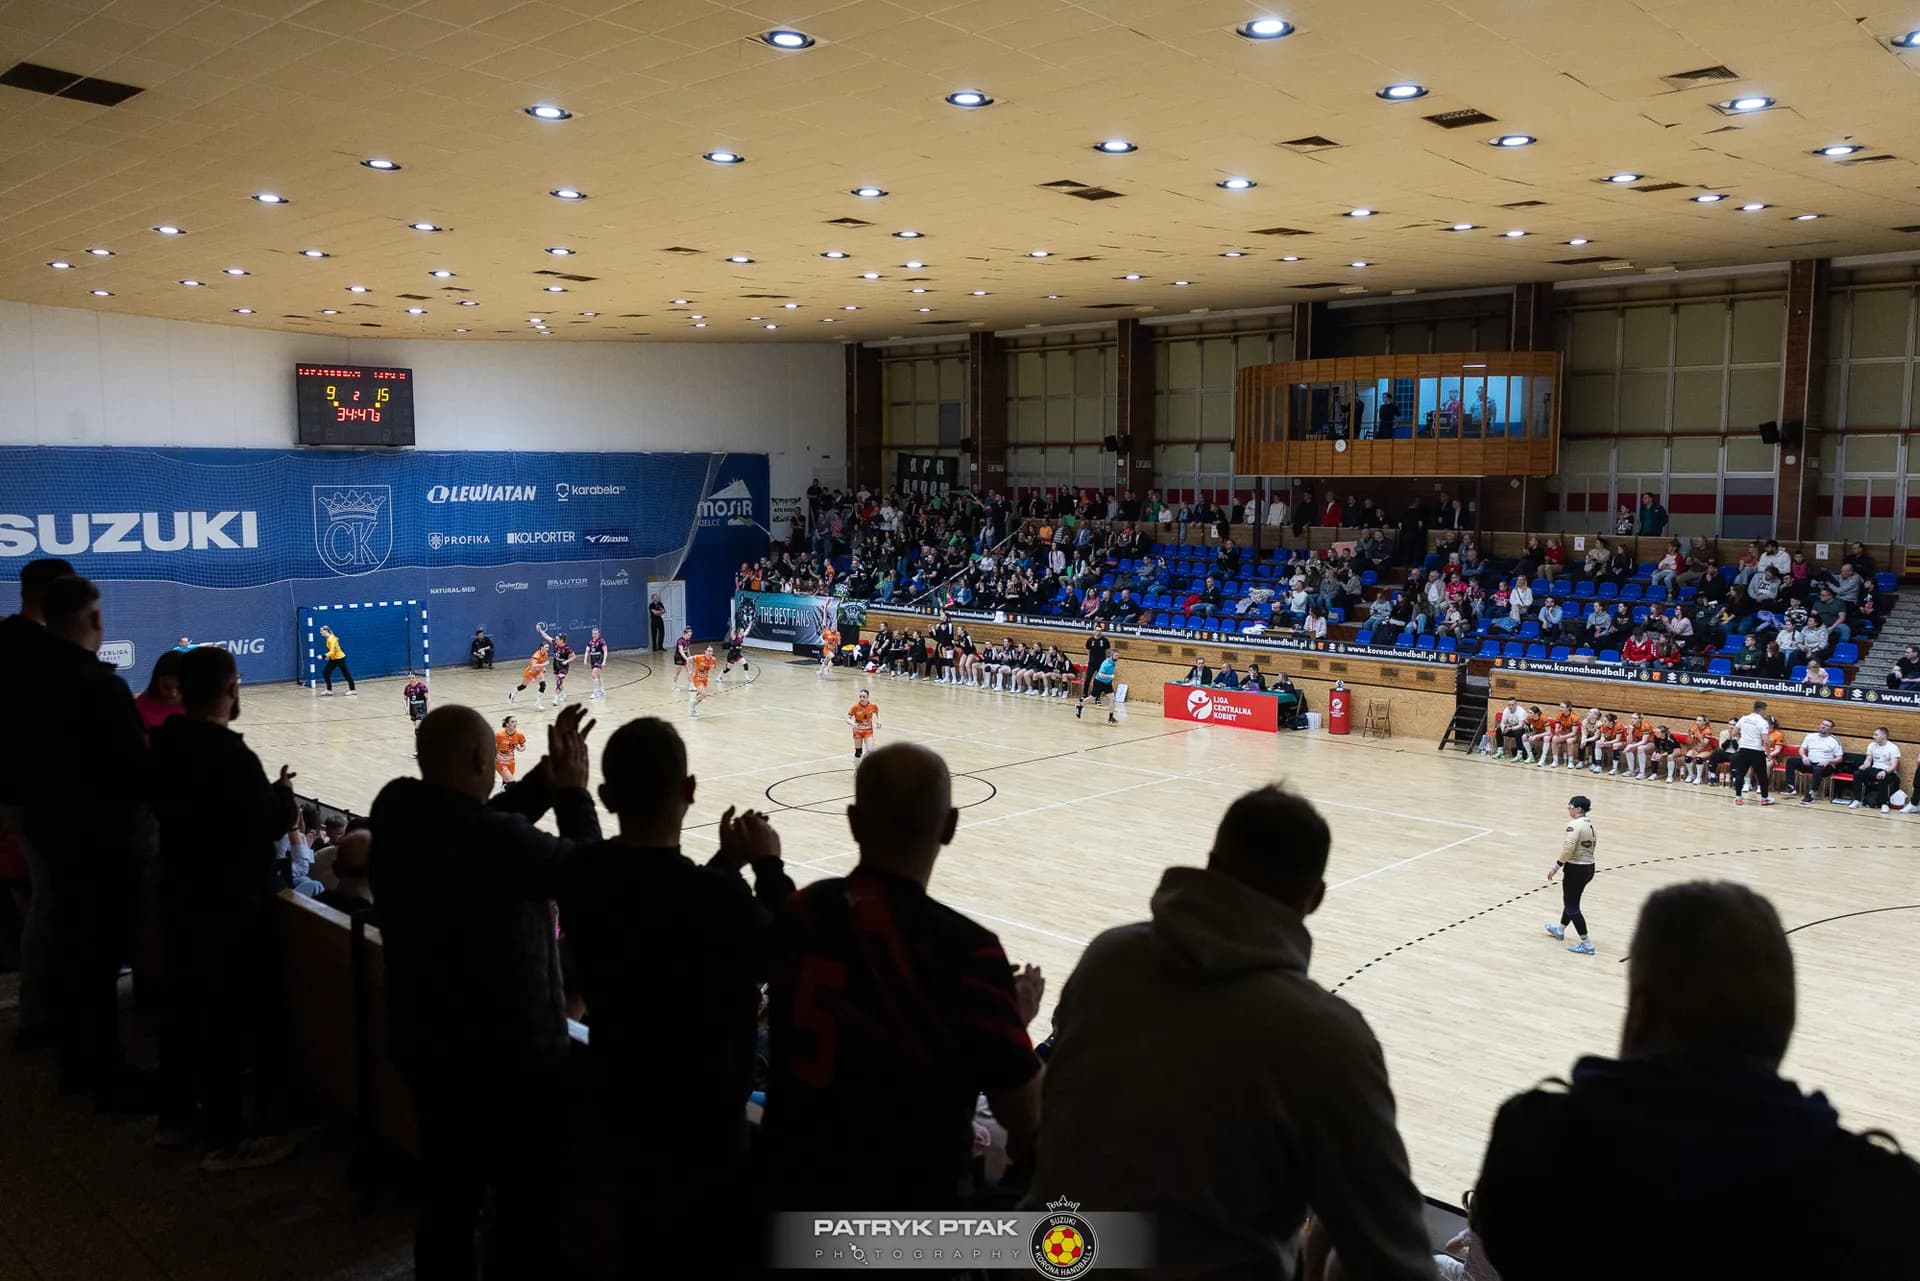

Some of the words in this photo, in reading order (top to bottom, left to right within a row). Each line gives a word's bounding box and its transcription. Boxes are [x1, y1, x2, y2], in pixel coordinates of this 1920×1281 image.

[327, 385, 336, 400] 9
[353, 391, 360, 401] 2
[377, 388, 390, 402] 15
[450, 483, 537, 502] LEWIATAN
[571, 485, 621, 496] karabela
[0, 511, 259, 557] SUZUKI
[444, 535, 491, 545] PROFIKA
[514, 531, 576, 545] KOLPORTER
[323, 521, 380, 567] CK
[759, 606, 773, 625] THE
[774, 607, 792, 626] BEST
[791, 609, 811, 628] FANS
[1228, 634, 1308, 650] www.koronahandball.pl
[1347, 644, 1437, 661] www.koronahandball.pl
[1529, 661, 1637, 679] www.koronahandball.pl
[1692, 674, 1816, 696] www.koronahandball.pl
[1212, 696, 1229, 705] LIGA
[1212, 704, 1252, 715] CENTRALNA
[1212, 713, 1237, 721] KOBIET
